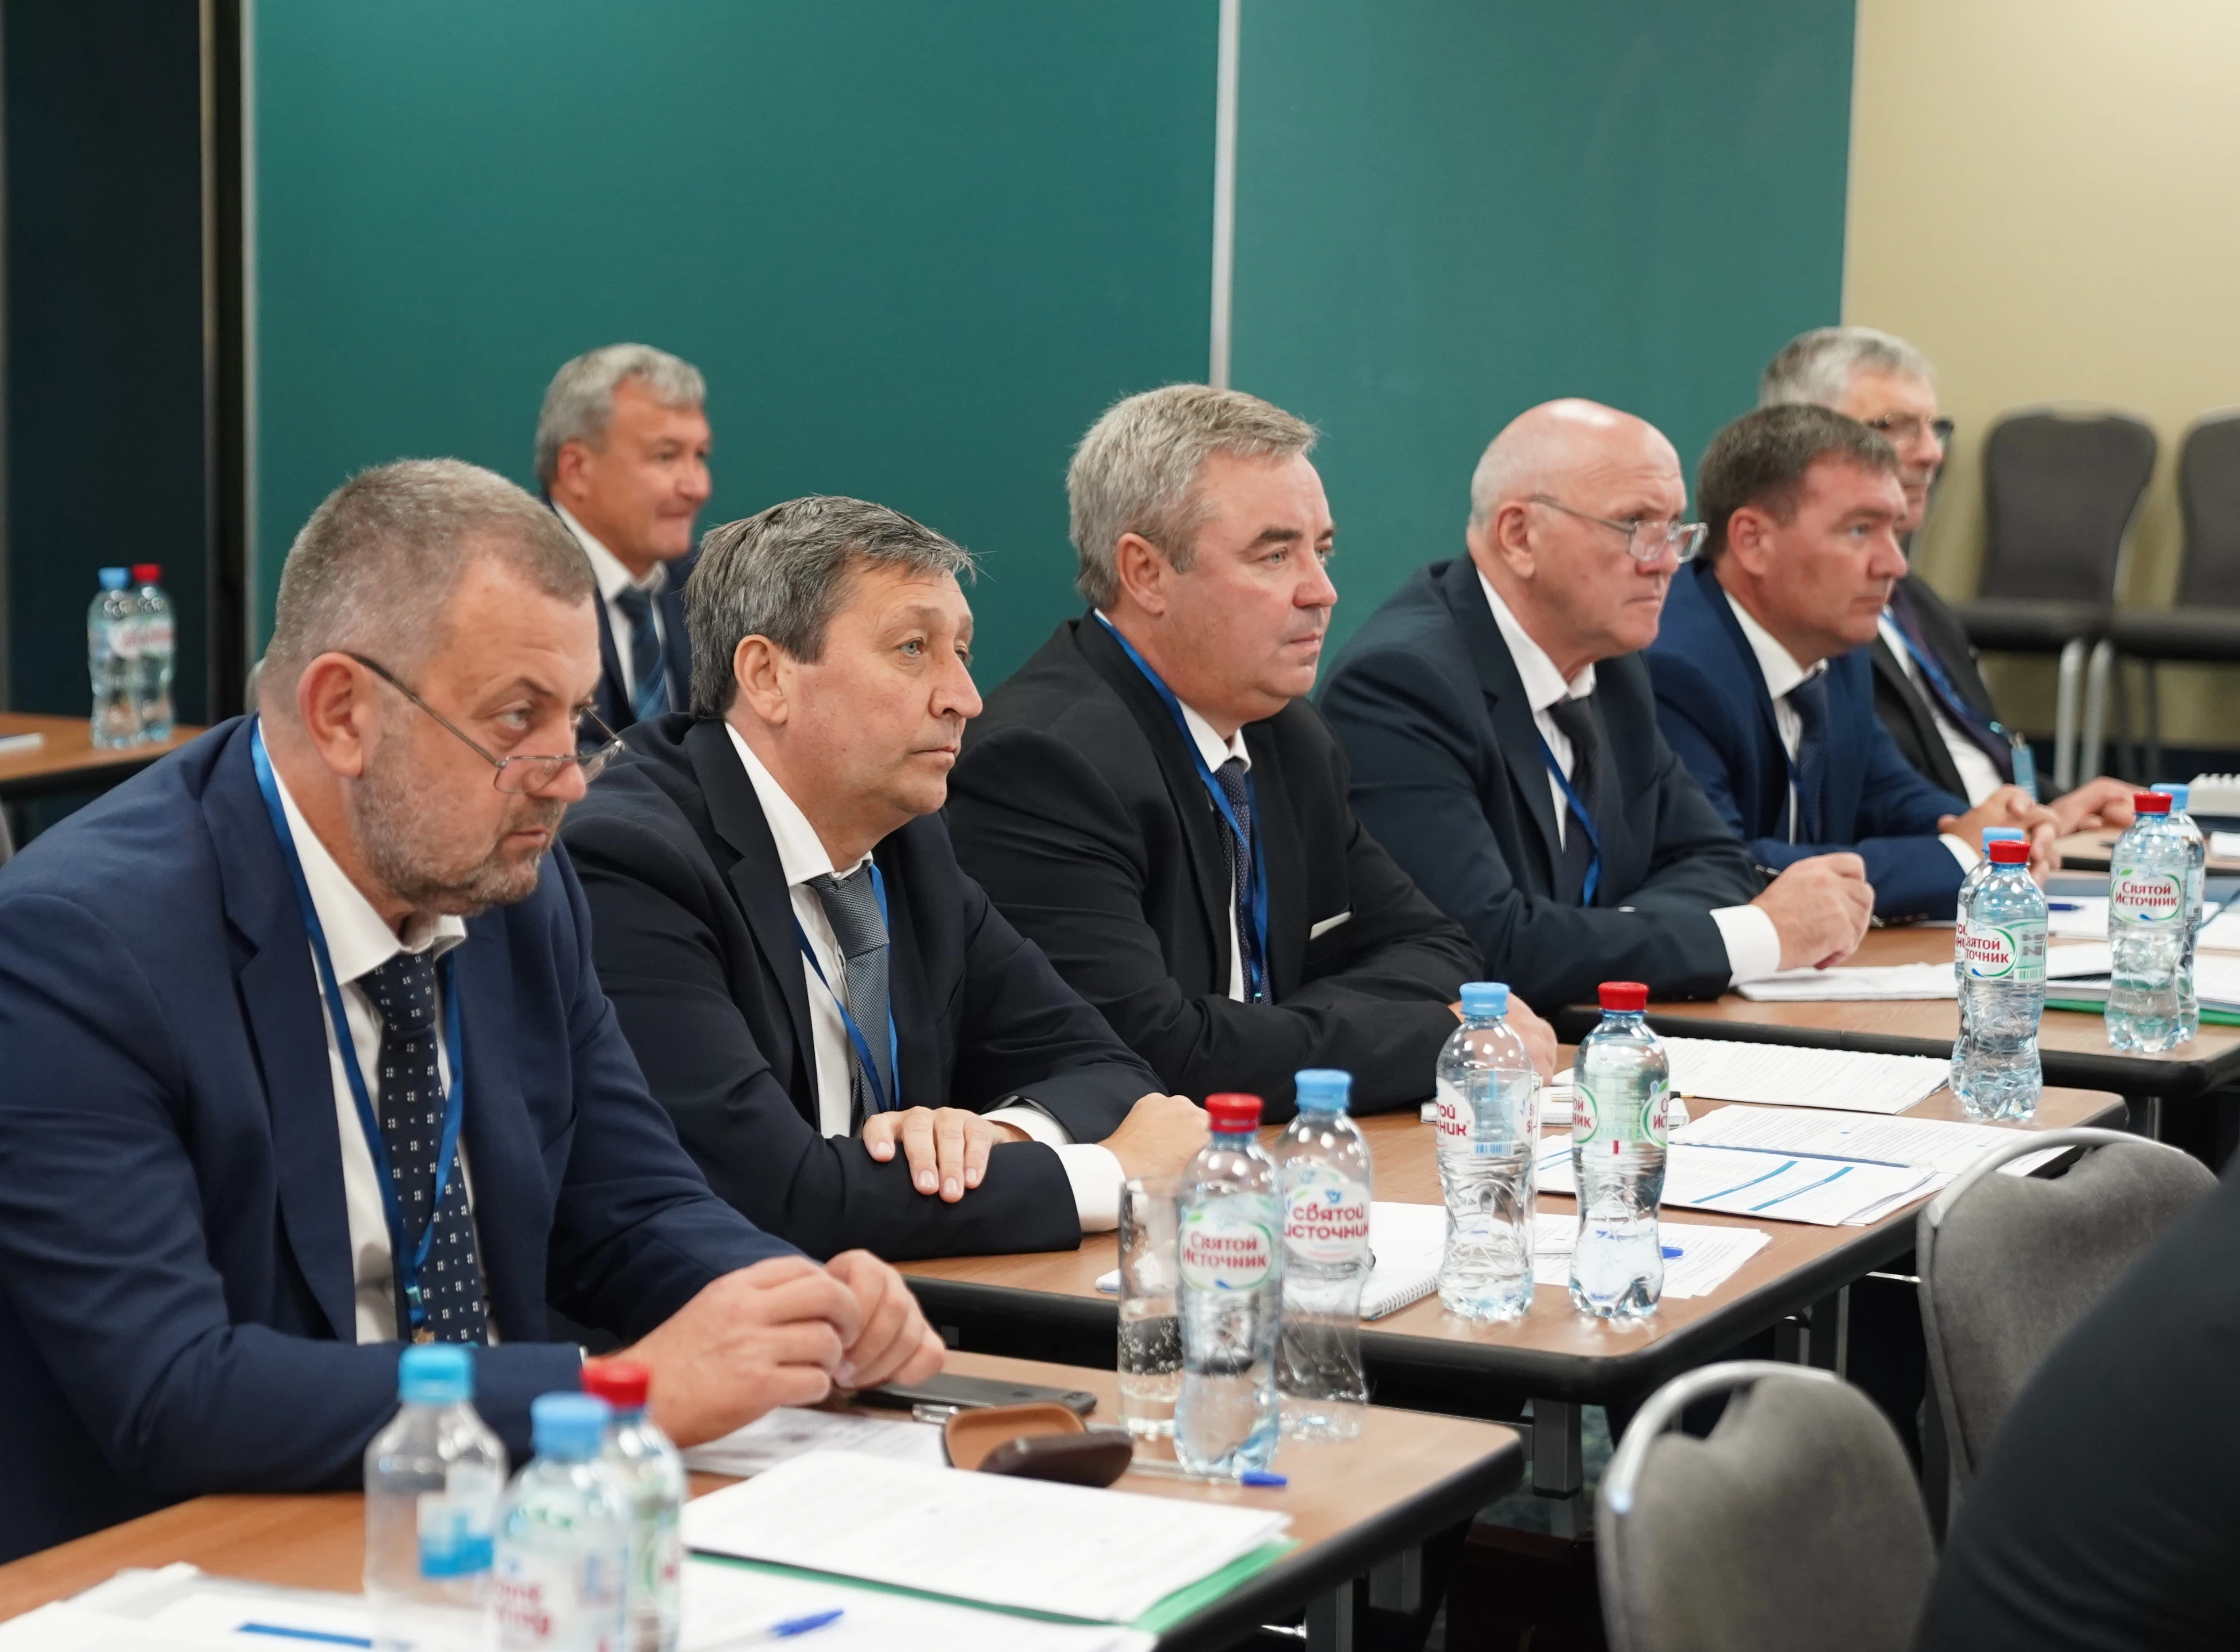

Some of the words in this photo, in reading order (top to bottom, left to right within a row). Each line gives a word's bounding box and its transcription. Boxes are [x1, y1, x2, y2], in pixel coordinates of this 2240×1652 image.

[2122, 881, 2171, 896] Святой
[2115, 892, 2177, 907] Источник
[1965, 937, 2000, 950] вятой
[1966, 948, 2009, 963] точник
